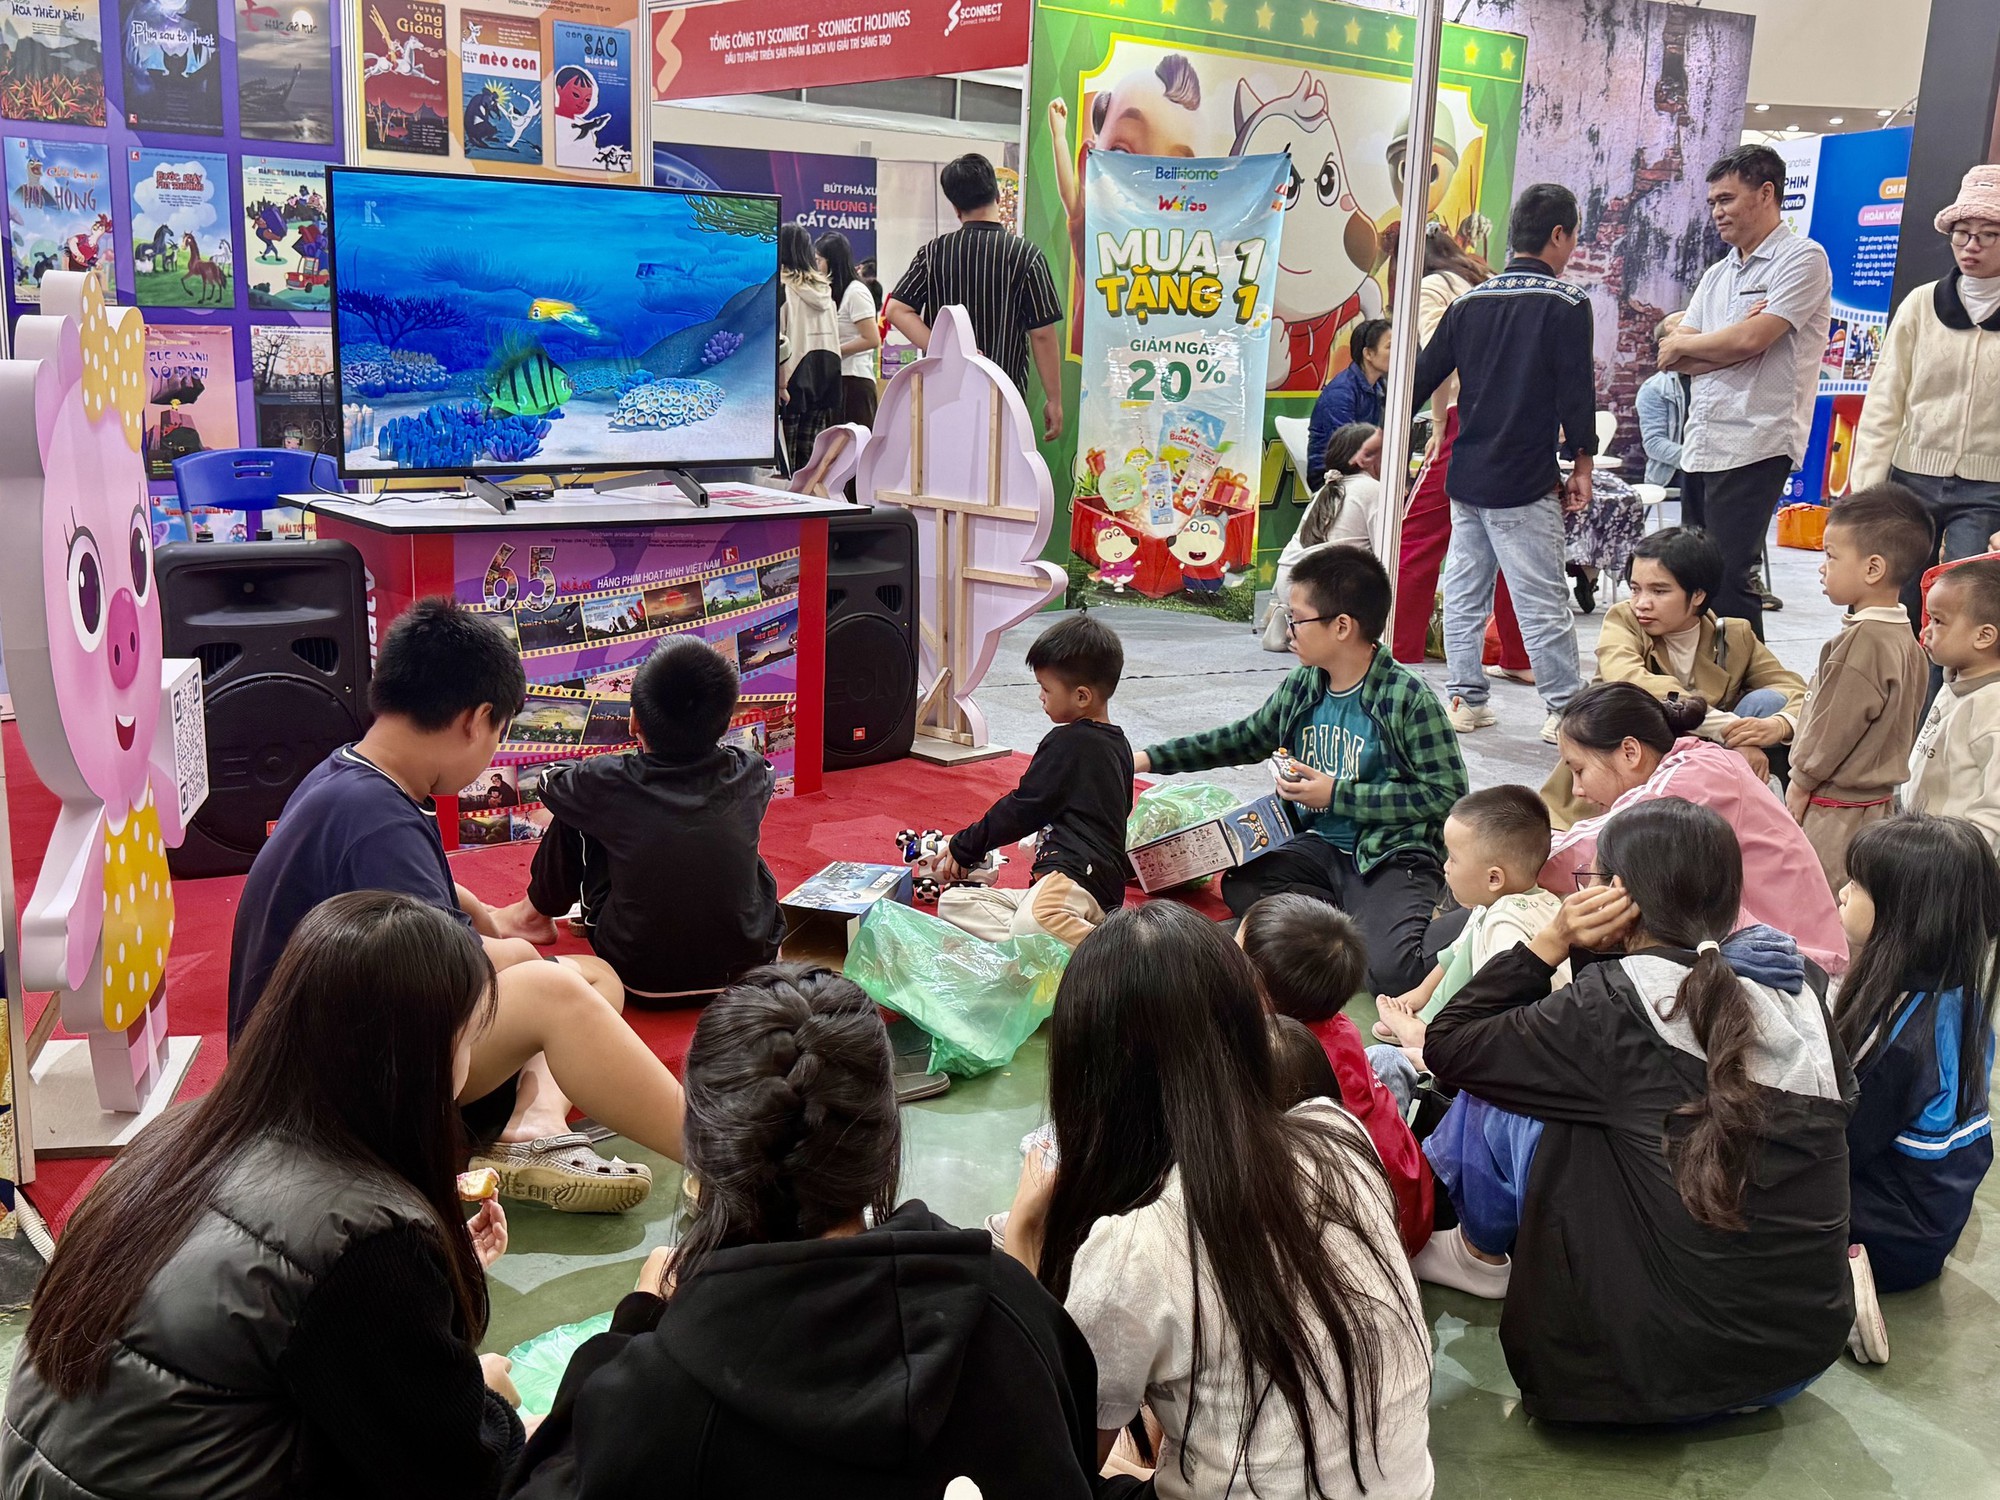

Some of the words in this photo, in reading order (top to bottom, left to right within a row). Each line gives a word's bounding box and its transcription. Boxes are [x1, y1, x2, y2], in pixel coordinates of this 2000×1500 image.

[414, 11, 443, 27] ông
[960, 3, 1003, 19] SCONNECT
[396, 17, 443, 39] Gióng
[709, 31, 731, 51] TỔNG
[732, 29, 755, 49] CÔNG
[756, 30, 767, 46] TY
[767, 24, 809, 44] SCONNECT
[817, 17, 863, 38] SCONNECT
[864, 9, 911, 31] HOLDINGS
[584, 33, 618, 57] SÁO
[812, 42, 826, 55] DỊCH
[860, 34, 878, 48] SÁNG
[878, 34, 892, 47] TẠO
[479, 51, 506, 68] mèo
[512, 58, 537, 71] con
[823, 182, 843, 194] BỨT
[843, 184, 864, 195] PHÁ
[1784, 175, 1809, 189] PHIM
[813, 198, 868, 213] THƯƠNG
[796, 210, 827, 228] CẤT
[827, 213, 870, 231] CÁNH
[1097, 228, 1220, 277] MUA
[1234, 238, 1267, 286] 1
[1095, 264, 1223, 326] TẶNG
[1232, 283, 1260, 325] 1
[1130, 336, 1172, 353] GIẢM
[1127, 359, 1226, 402] 20%
[482, 542, 558, 613] 65
[560, 577, 592, 592] NĂM
[597, 576, 621, 590] HÃNG
[621, 573, 642, 586] PHIM
[642, 569, 665, 583] HOẠT
[665, 565, 685, 579] HÌNH
[685, 562, 704, 575] VIỆT
[704, 558, 721, 571] NAM
[1301, 724, 1365, 781] RUN
